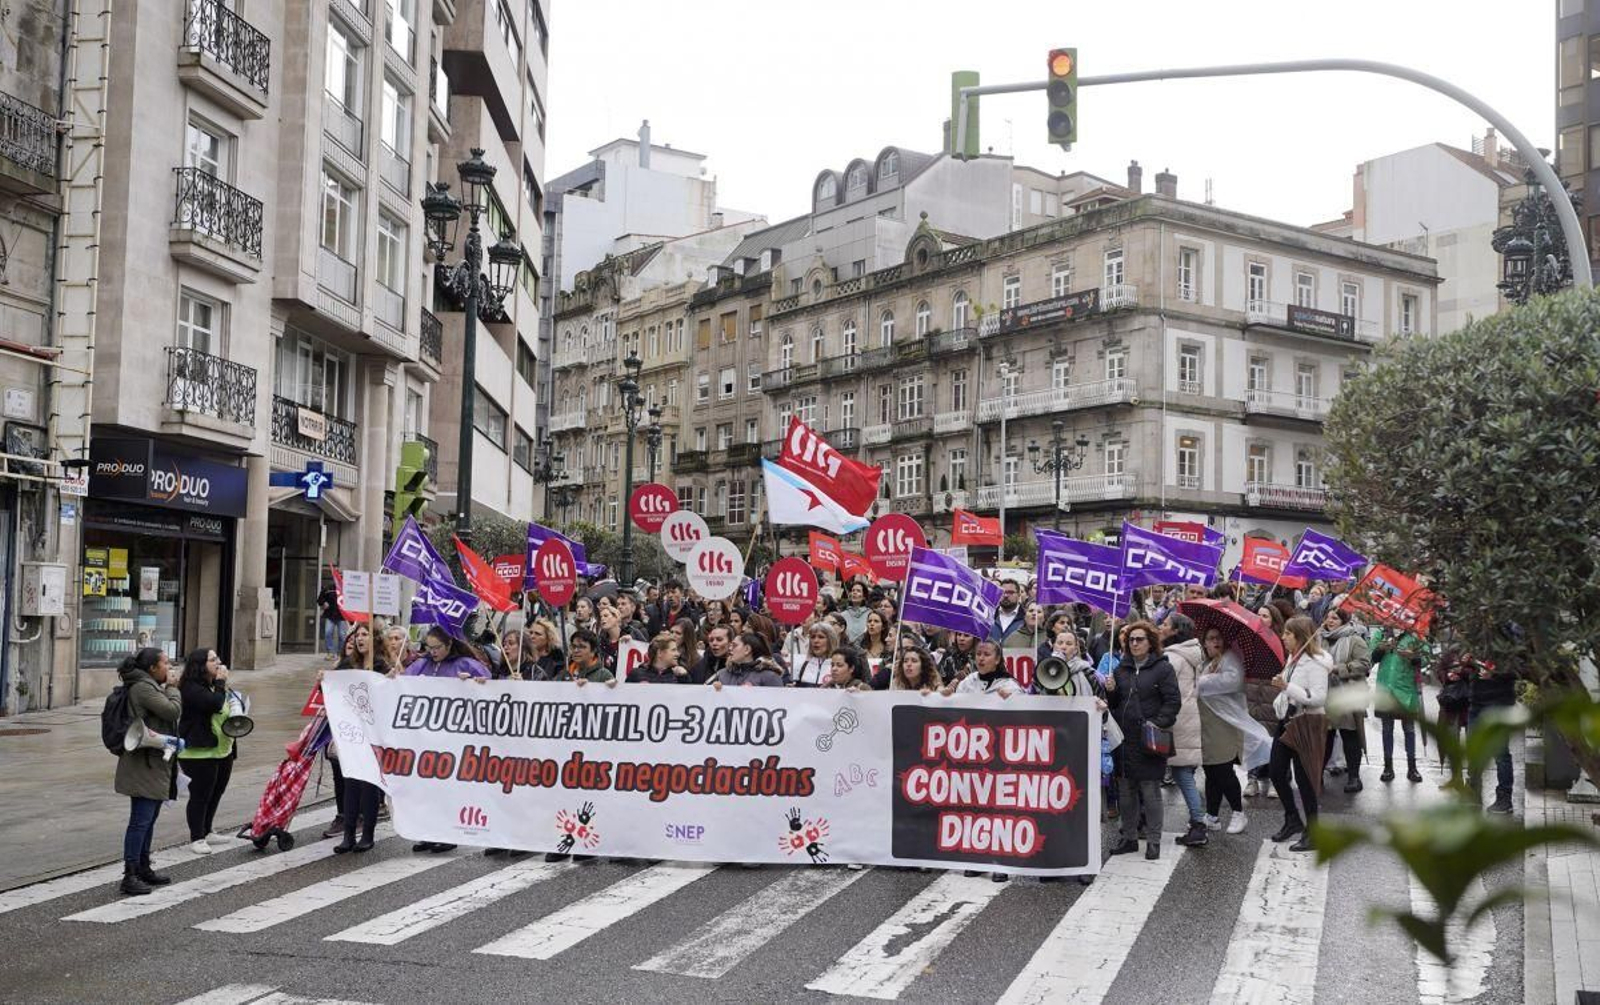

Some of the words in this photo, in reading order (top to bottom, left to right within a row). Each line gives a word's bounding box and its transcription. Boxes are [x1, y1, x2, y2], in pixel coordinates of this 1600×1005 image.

[790, 424, 842, 478] CIG
[639, 493, 671, 513] CIG
[670, 522, 702, 541] CIG
[876, 528, 914, 553] CIG
[542, 553, 569, 578] CIG
[698, 550, 733, 574] CIG
[776, 571, 809, 597] CIG
[910, 575, 989, 619] CCOO
[392, 693, 527, 735] EDUCACIÓN
[524, 702, 644, 741] INFANTIL
[647, 703, 705, 744] 0-3
[705, 707, 788, 746] ANOS
[926, 724, 991, 762] POR
[1003, 727, 1051, 762] UN
[416, 751, 456, 779] ao
[456, 745, 560, 794] bloqueo
[560, 751, 613, 791] das
[614, 755, 816, 802] negociacións
[905, 767, 1073, 811] CONVENIO
[459, 806, 488, 827] CIG
[665, 824, 705, 839] SNEP
[939, 814, 1036, 855] DIGNO
